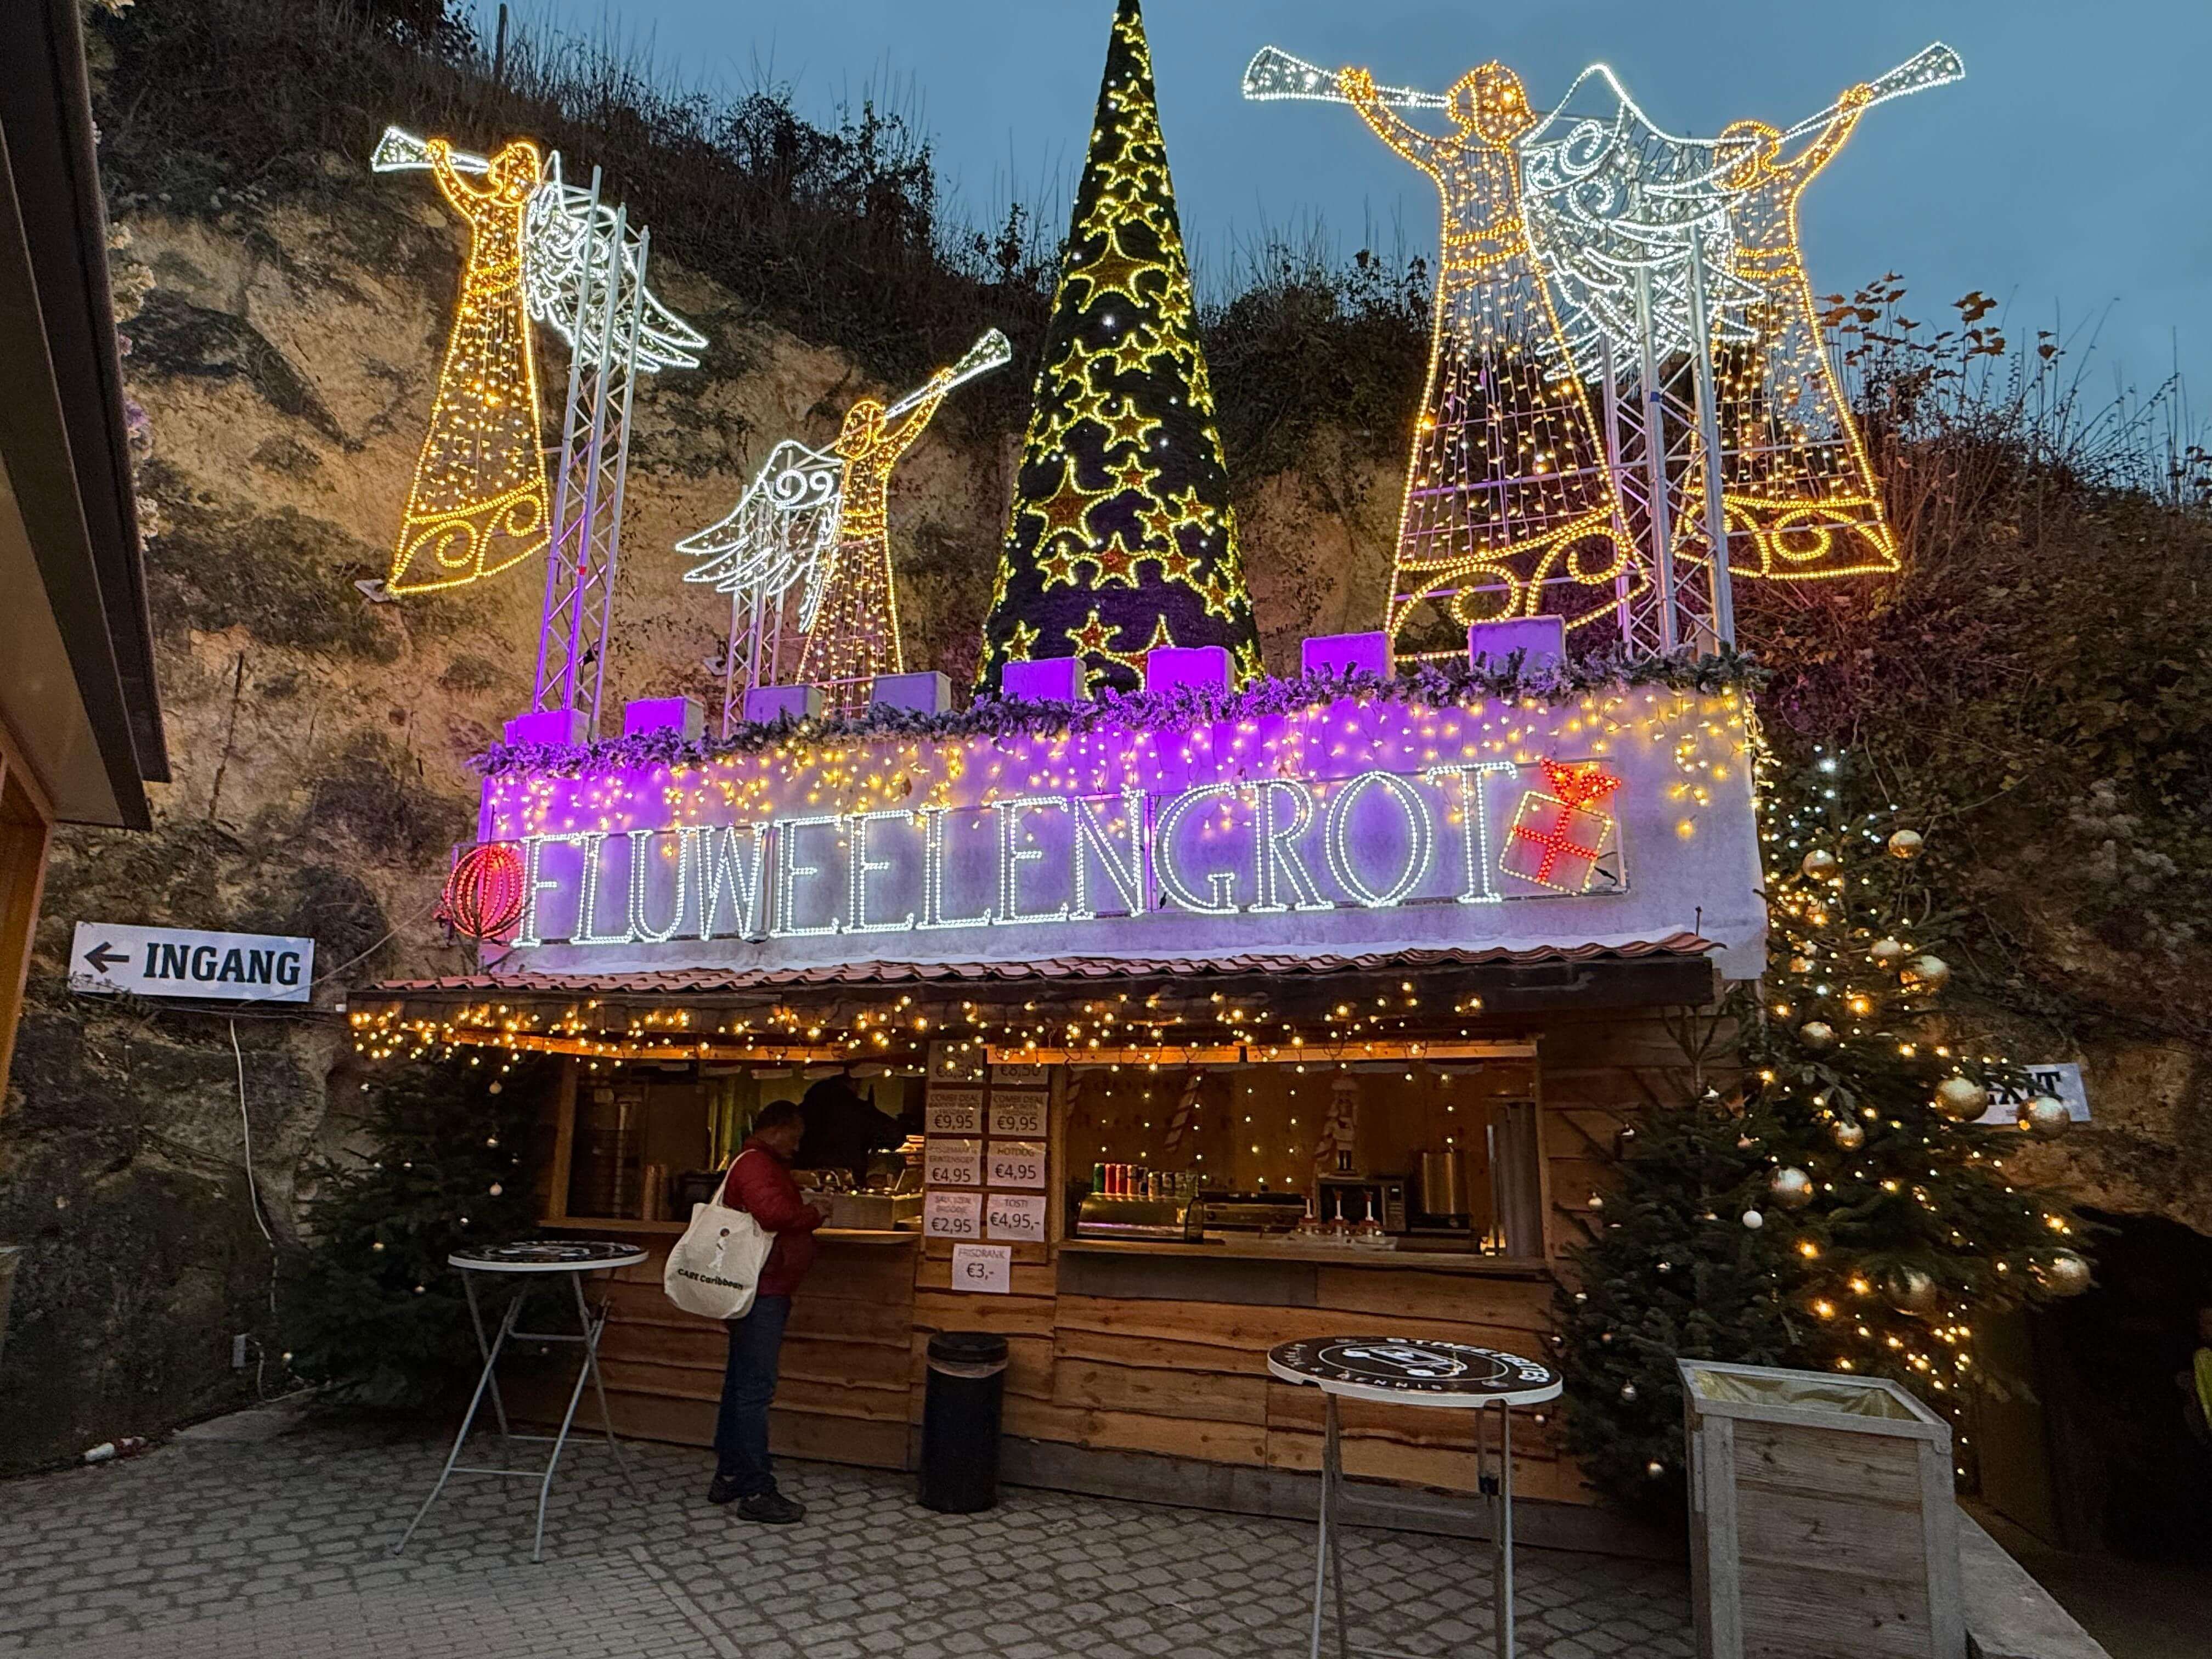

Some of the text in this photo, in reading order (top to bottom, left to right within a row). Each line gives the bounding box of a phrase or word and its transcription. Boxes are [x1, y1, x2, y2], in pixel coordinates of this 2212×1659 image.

[511, 761, 1517, 948] FLUWEELENGROT
[143, 942, 301, 986] INGANG
[934, 1115, 973, 1130] €9,95
[997, 1116, 1037, 1131] €9,95
[933, 1167, 971, 1182] €4,95
[995, 1164, 1036, 1181] €4,95
[1004, 1198, 1028, 1208] TOSTI
[932, 1217, 972, 1233] €2,95
[990, 1212, 1040, 1231] €4,95,-
[967, 1263, 994, 1280] €3,-
[699, 1274, 743, 1290] Caribbean
